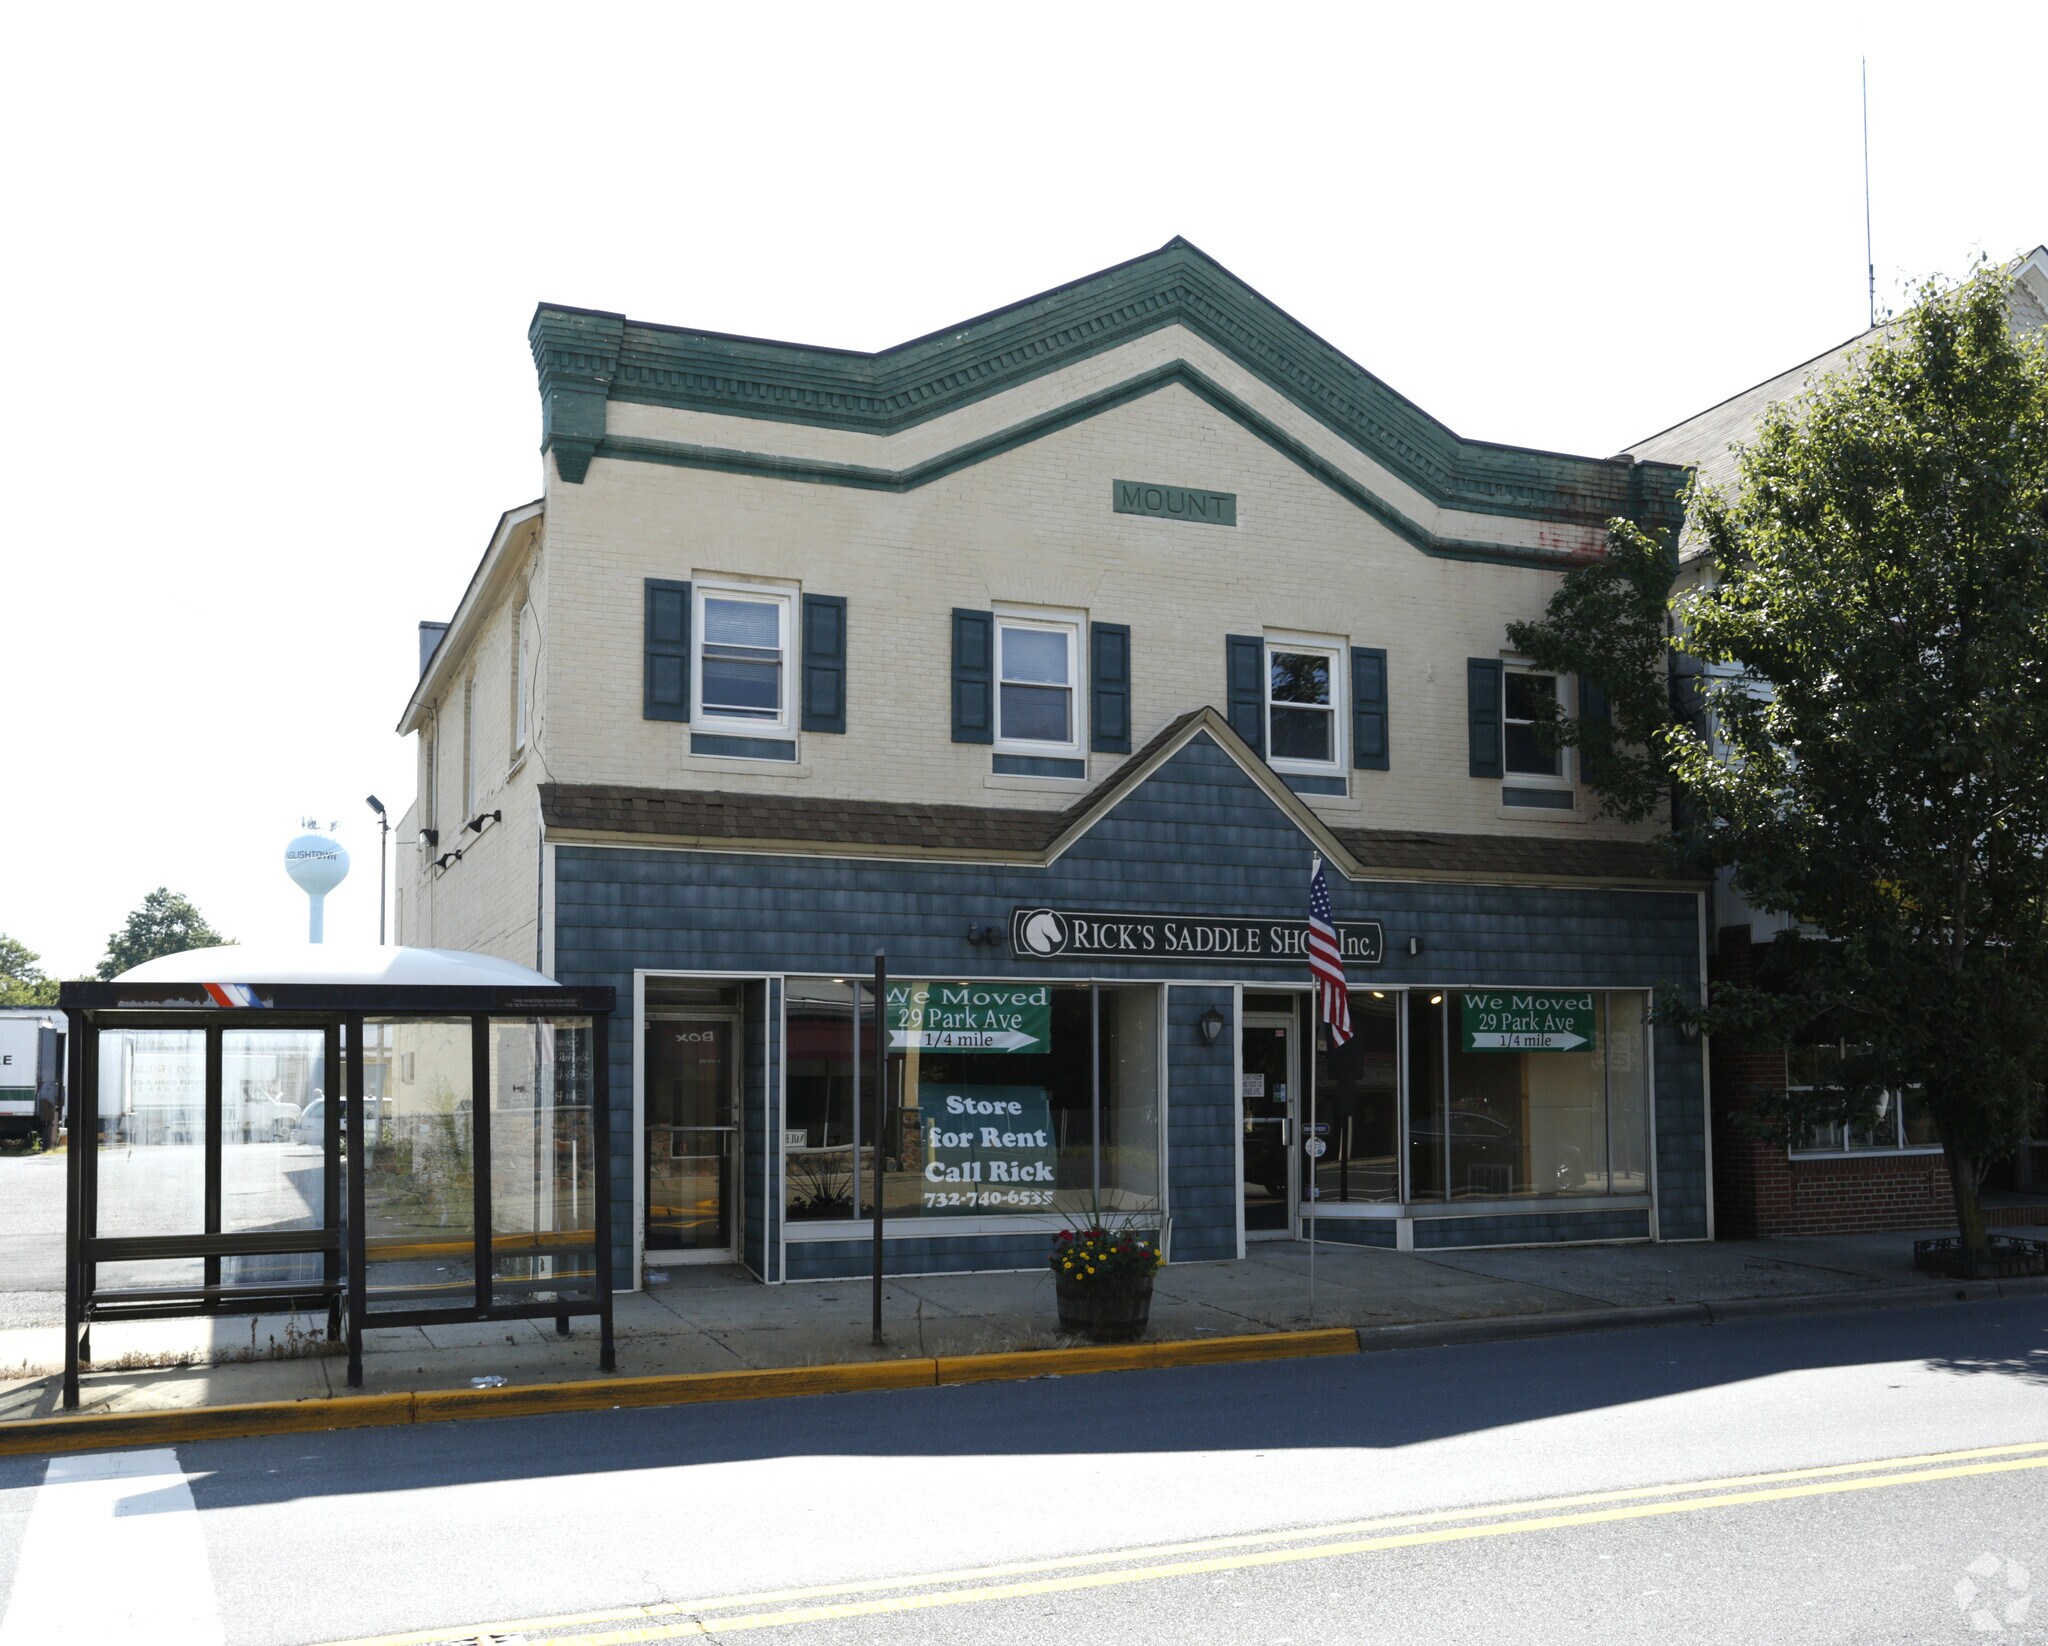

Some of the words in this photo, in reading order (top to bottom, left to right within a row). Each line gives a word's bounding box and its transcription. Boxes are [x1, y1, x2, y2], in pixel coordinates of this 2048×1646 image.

[1123, 485, 1228, 518] MOUNT
[1072, 919, 1156, 951] RICK'S
[1164, 922, 1261, 953] SADDLE
[1270, 926, 1311, 955] SHO
[1338, 927, 1375, 957] Inc.
[886, 987, 931, 1004] We
[941, 986, 1048, 1006] Moved
[1464, 994, 1503, 1010] We
[1511, 993, 1594, 1011] Moved
[898, 1008, 923, 1028] 29
[928, 1006, 978, 1029] Park
[983, 1009, 1023, 1030] Ave
[1479, 1013, 1497, 1031] 29
[1501, 1010, 1540, 1031] Park
[1544, 1013, 1575, 1031] Ave
[925, 1030, 953, 1048] 1/4
[957, 1031, 993, 1048] mile
[1500, 1033, 1521, 1048] 1/4
[1524, 1033, 1552, 1047] mile
[946, 1095, 1022, 1115] Store
[929, 1127, 974, 1148] for
[980, 1127, 1048, 1148] Rent
[925, 1161, 982, 1183] Call
[988, 1161, 1055, 1182] Rick
[924, 1190, 1054, 1208] 732-740-6535
